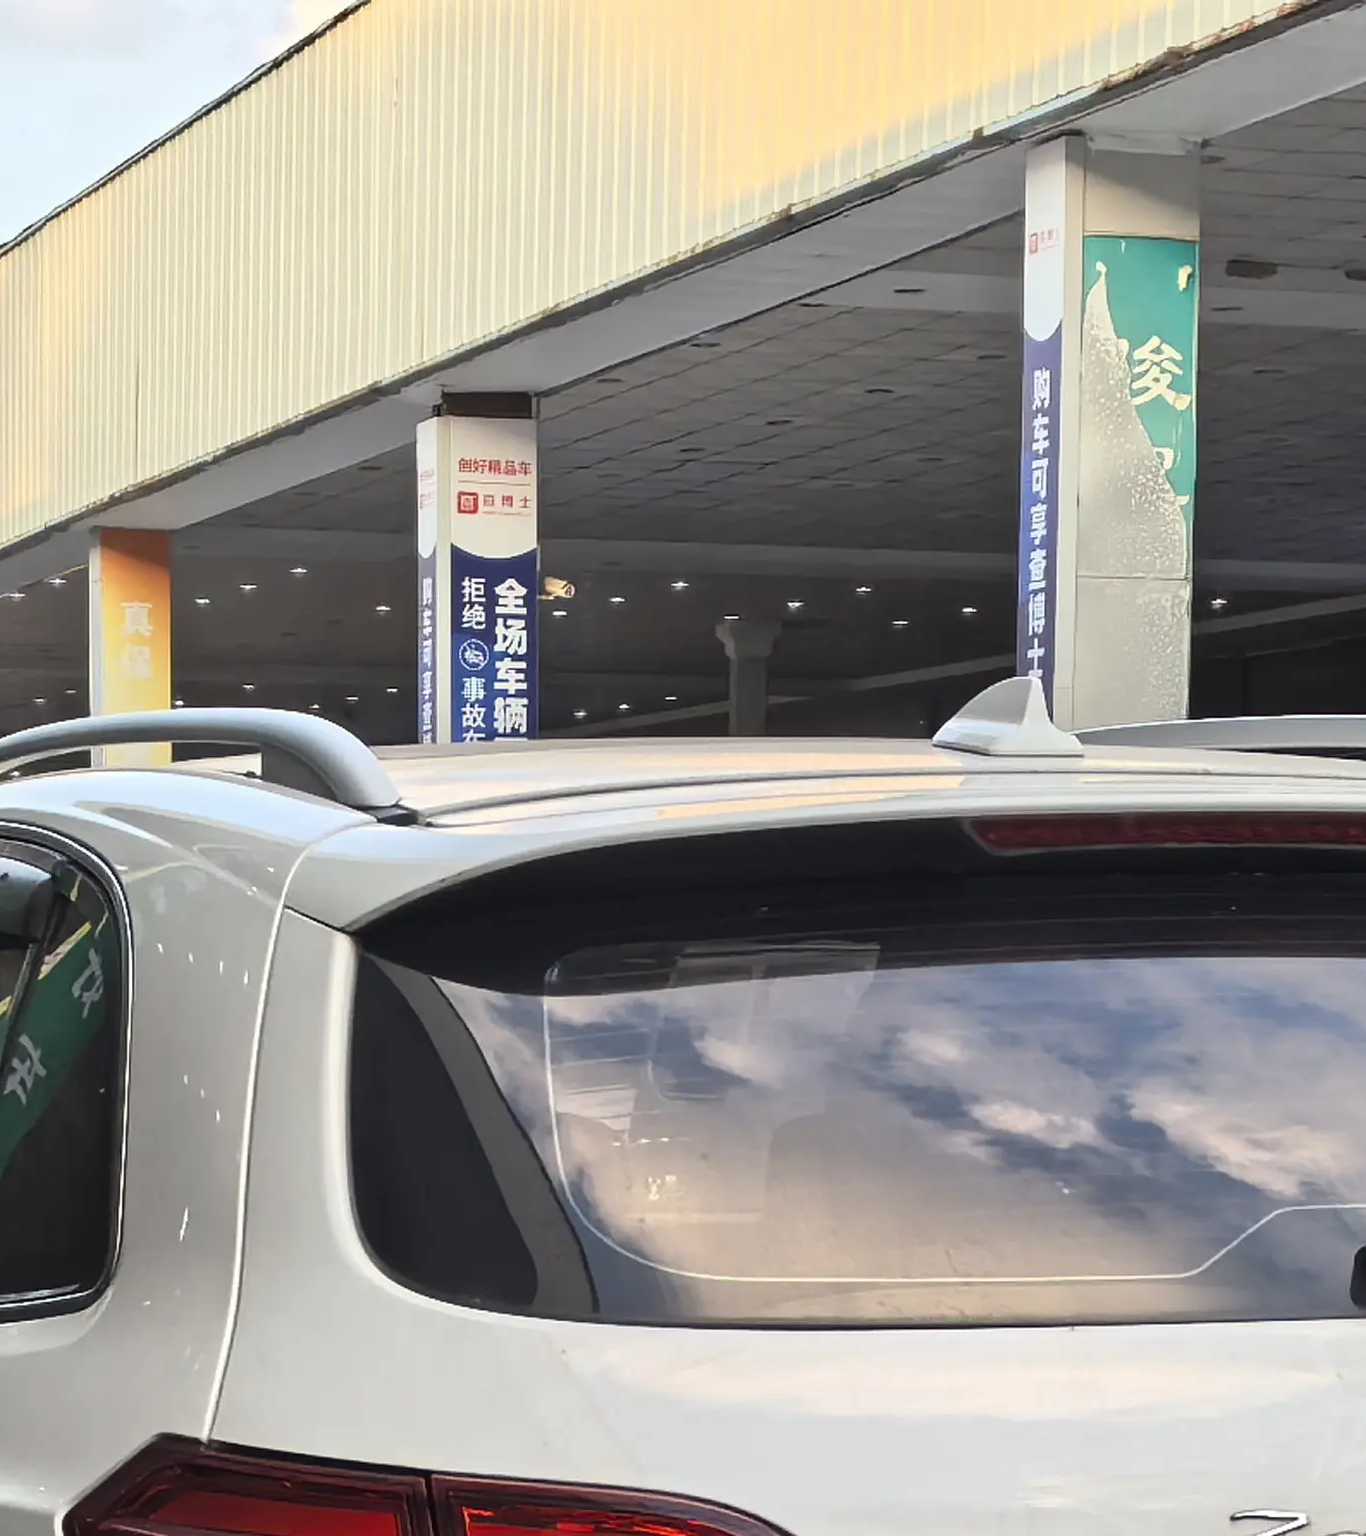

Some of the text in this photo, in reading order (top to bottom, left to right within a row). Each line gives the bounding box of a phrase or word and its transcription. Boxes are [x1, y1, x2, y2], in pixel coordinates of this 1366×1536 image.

[460, 576, 487, 630] 拒绝
[492, 577, 529, 743] 全场车辆
